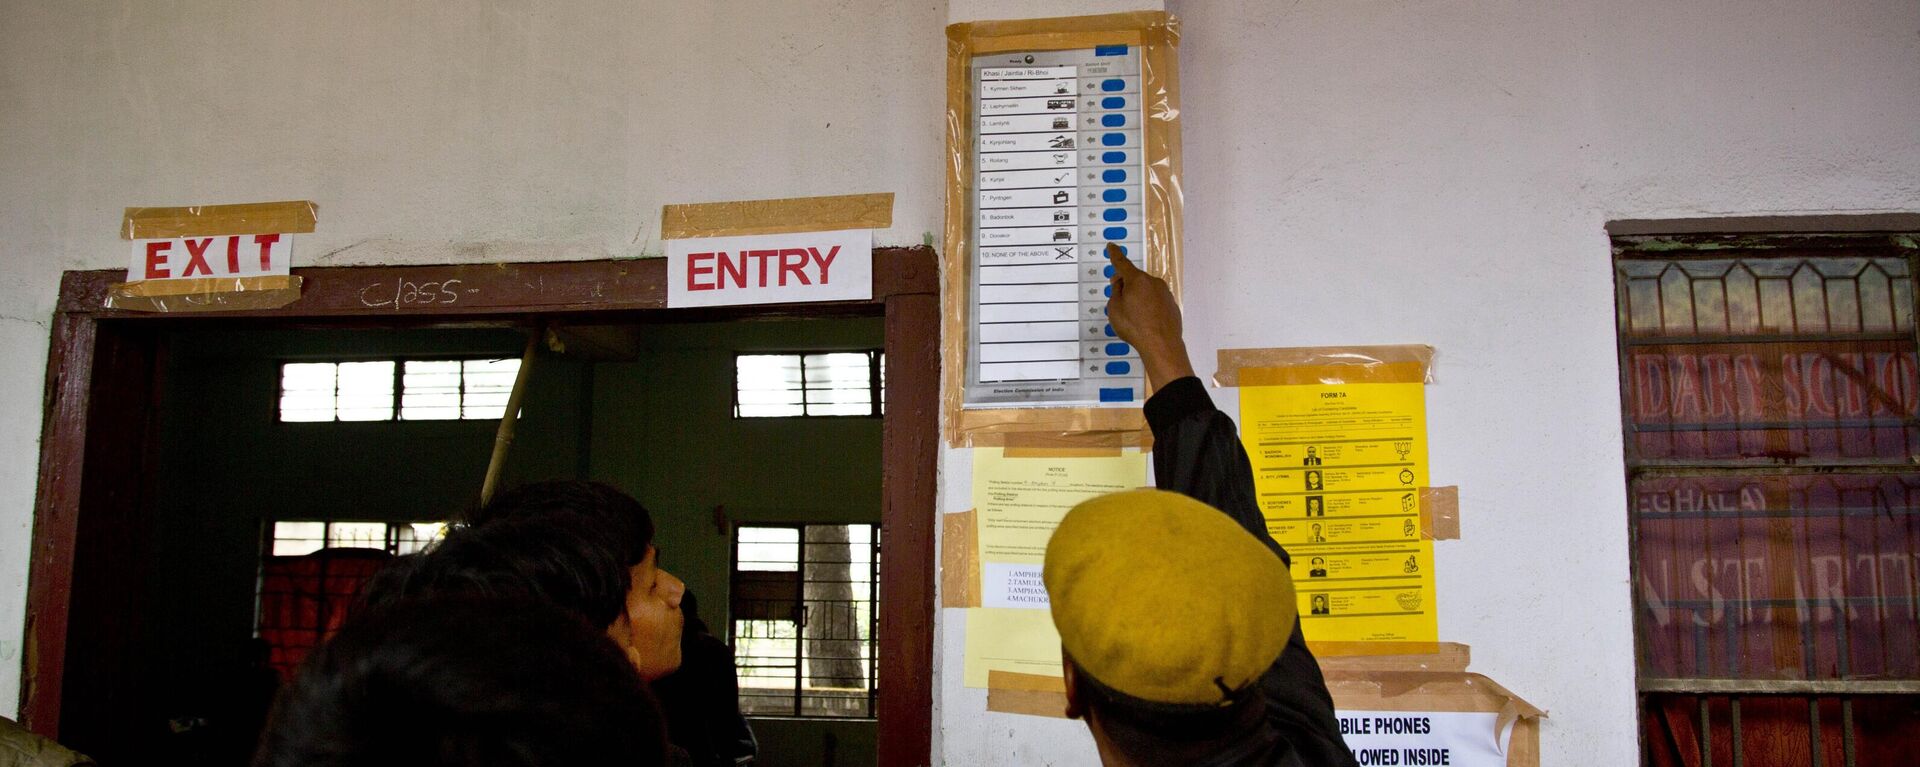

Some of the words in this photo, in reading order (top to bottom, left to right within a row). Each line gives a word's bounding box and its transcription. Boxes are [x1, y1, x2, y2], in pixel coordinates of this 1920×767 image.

[145, 233, 280, 279] EXIT
[687, 245, 841, 291] ENTRY
[1320, 391, 1338, 399] FORM
[1339, 391, 1347, 399] 7A
[1631, 354, 1764, 418] DARY
[1375, 717, 1431, 735] PHONES
[1403, 748, 1450, 766] INSIDE
